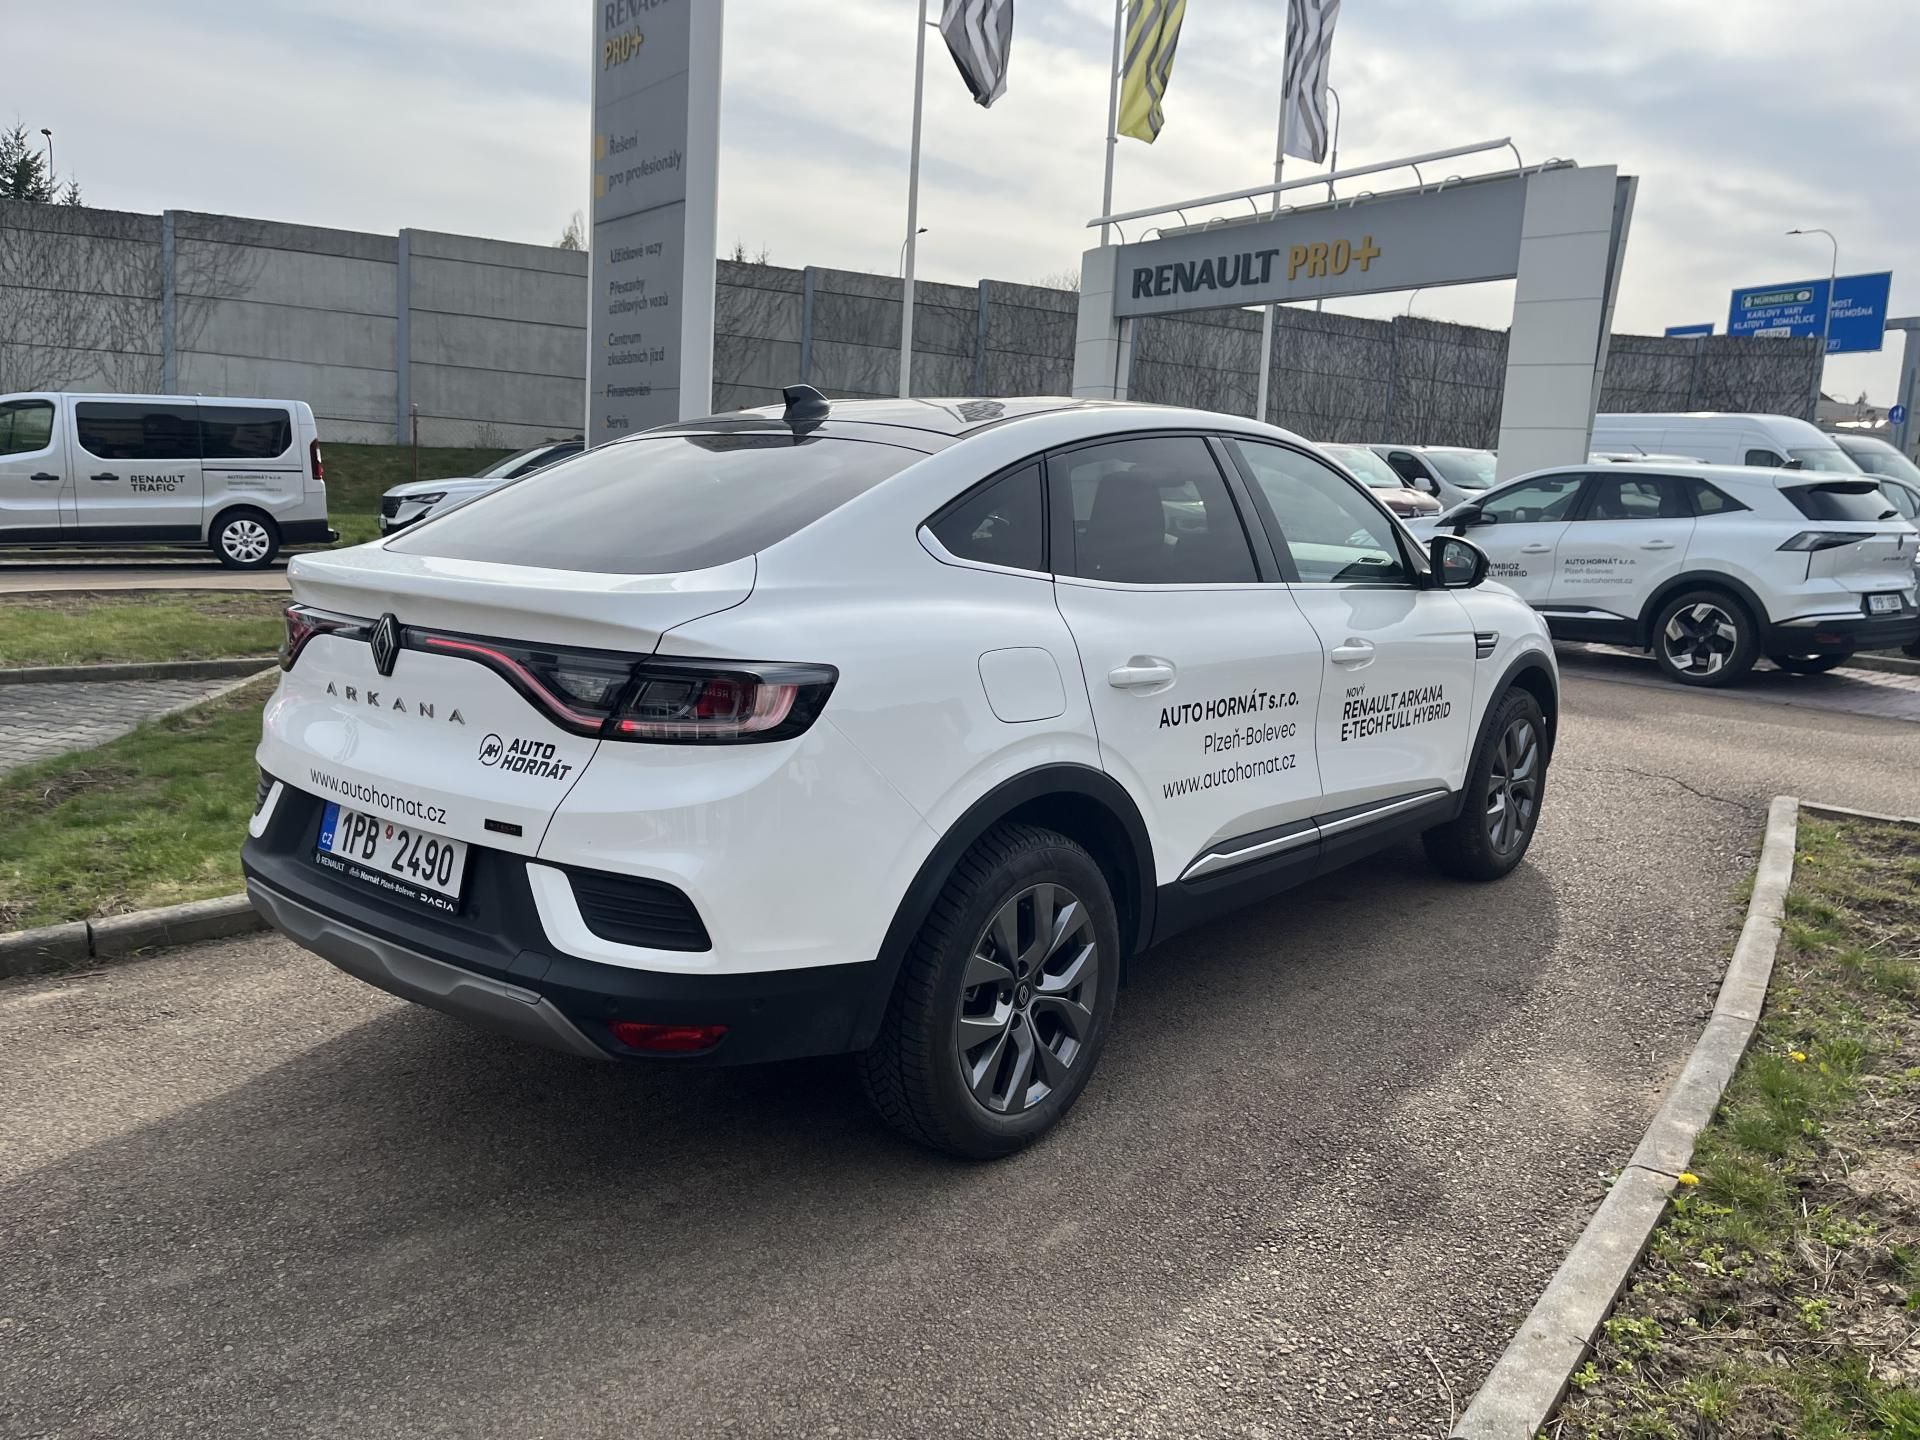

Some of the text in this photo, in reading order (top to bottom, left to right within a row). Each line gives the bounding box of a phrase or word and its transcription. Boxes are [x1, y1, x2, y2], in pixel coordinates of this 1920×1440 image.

[605, 0, 668, 32] RENA
[603, 25, 645, 72] PRO+
[609, 130, 639, 156] Řešení
[608, 149, 682, 192] pro profesionály
[1131, 235, 1381, 299] RENAULT PRO+
[1733, 319, 1766, 330] KLATOVY
[1746, 306, 1804, 320] KARLOVY VARY
[606, 415, 629, 428] Servis
[130, 474, 185, 484] RENAULT
[130, 483, 176, 492] TRAFIC
[1489, 562, 1520, 570] YMBIOZ
[326, 681, 466, 725] ARKANA
[1342, 684, 1443, 721] RENAULT ARKANA
[1345, 682, 1366, 699] NOVÝ
[1159, 688, 1300, 729] AUTO HORNÁT s.r.o.
[1341, 701, 1452, 742] E-TECH FULL HYBRID
[508, 738, 556, 760] AUTO
[1204, 722, 1297, 755] Plzeň-Bolevec
[500, 754, 573, 781] HORNÁT
[1162, 754, 1297, 799] www.autohornat.cz
[310, 768, 447, 825] www.autohornat.cz
[321, 811, 454, 886] CZ 1PB 2490
[321, 855, 346, 872] RENAULT
[419, 892, 455, 912] DACIA
